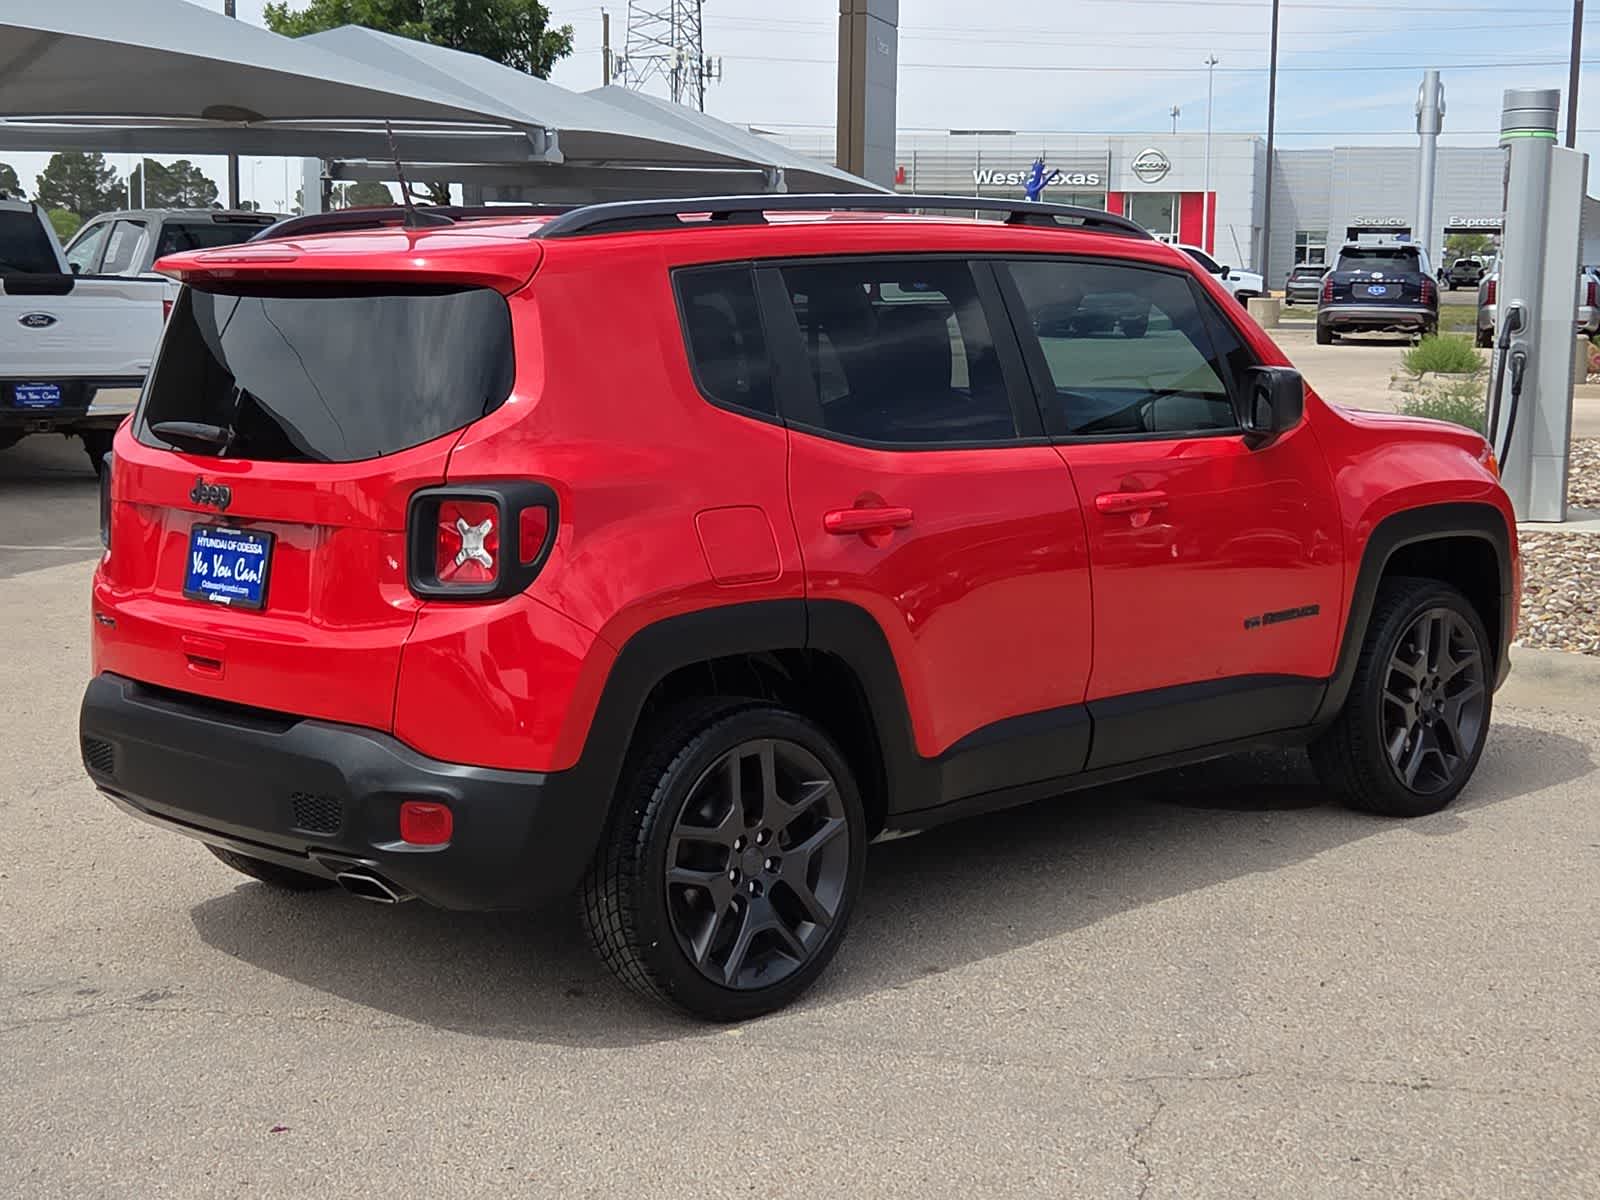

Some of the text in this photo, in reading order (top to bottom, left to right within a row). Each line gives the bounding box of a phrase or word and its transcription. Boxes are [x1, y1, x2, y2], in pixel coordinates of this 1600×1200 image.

[1134, 162, 1168, 170] NISSAN
[973, 169, 1026, 186] West
[27, 315, 49, 325] Ford
[190, 475, 232, 512] Jeep
[197, 536, 263, 555] HYUNDAI OF ODESSA
[192, 551, 265, 584] Yes You Can!
